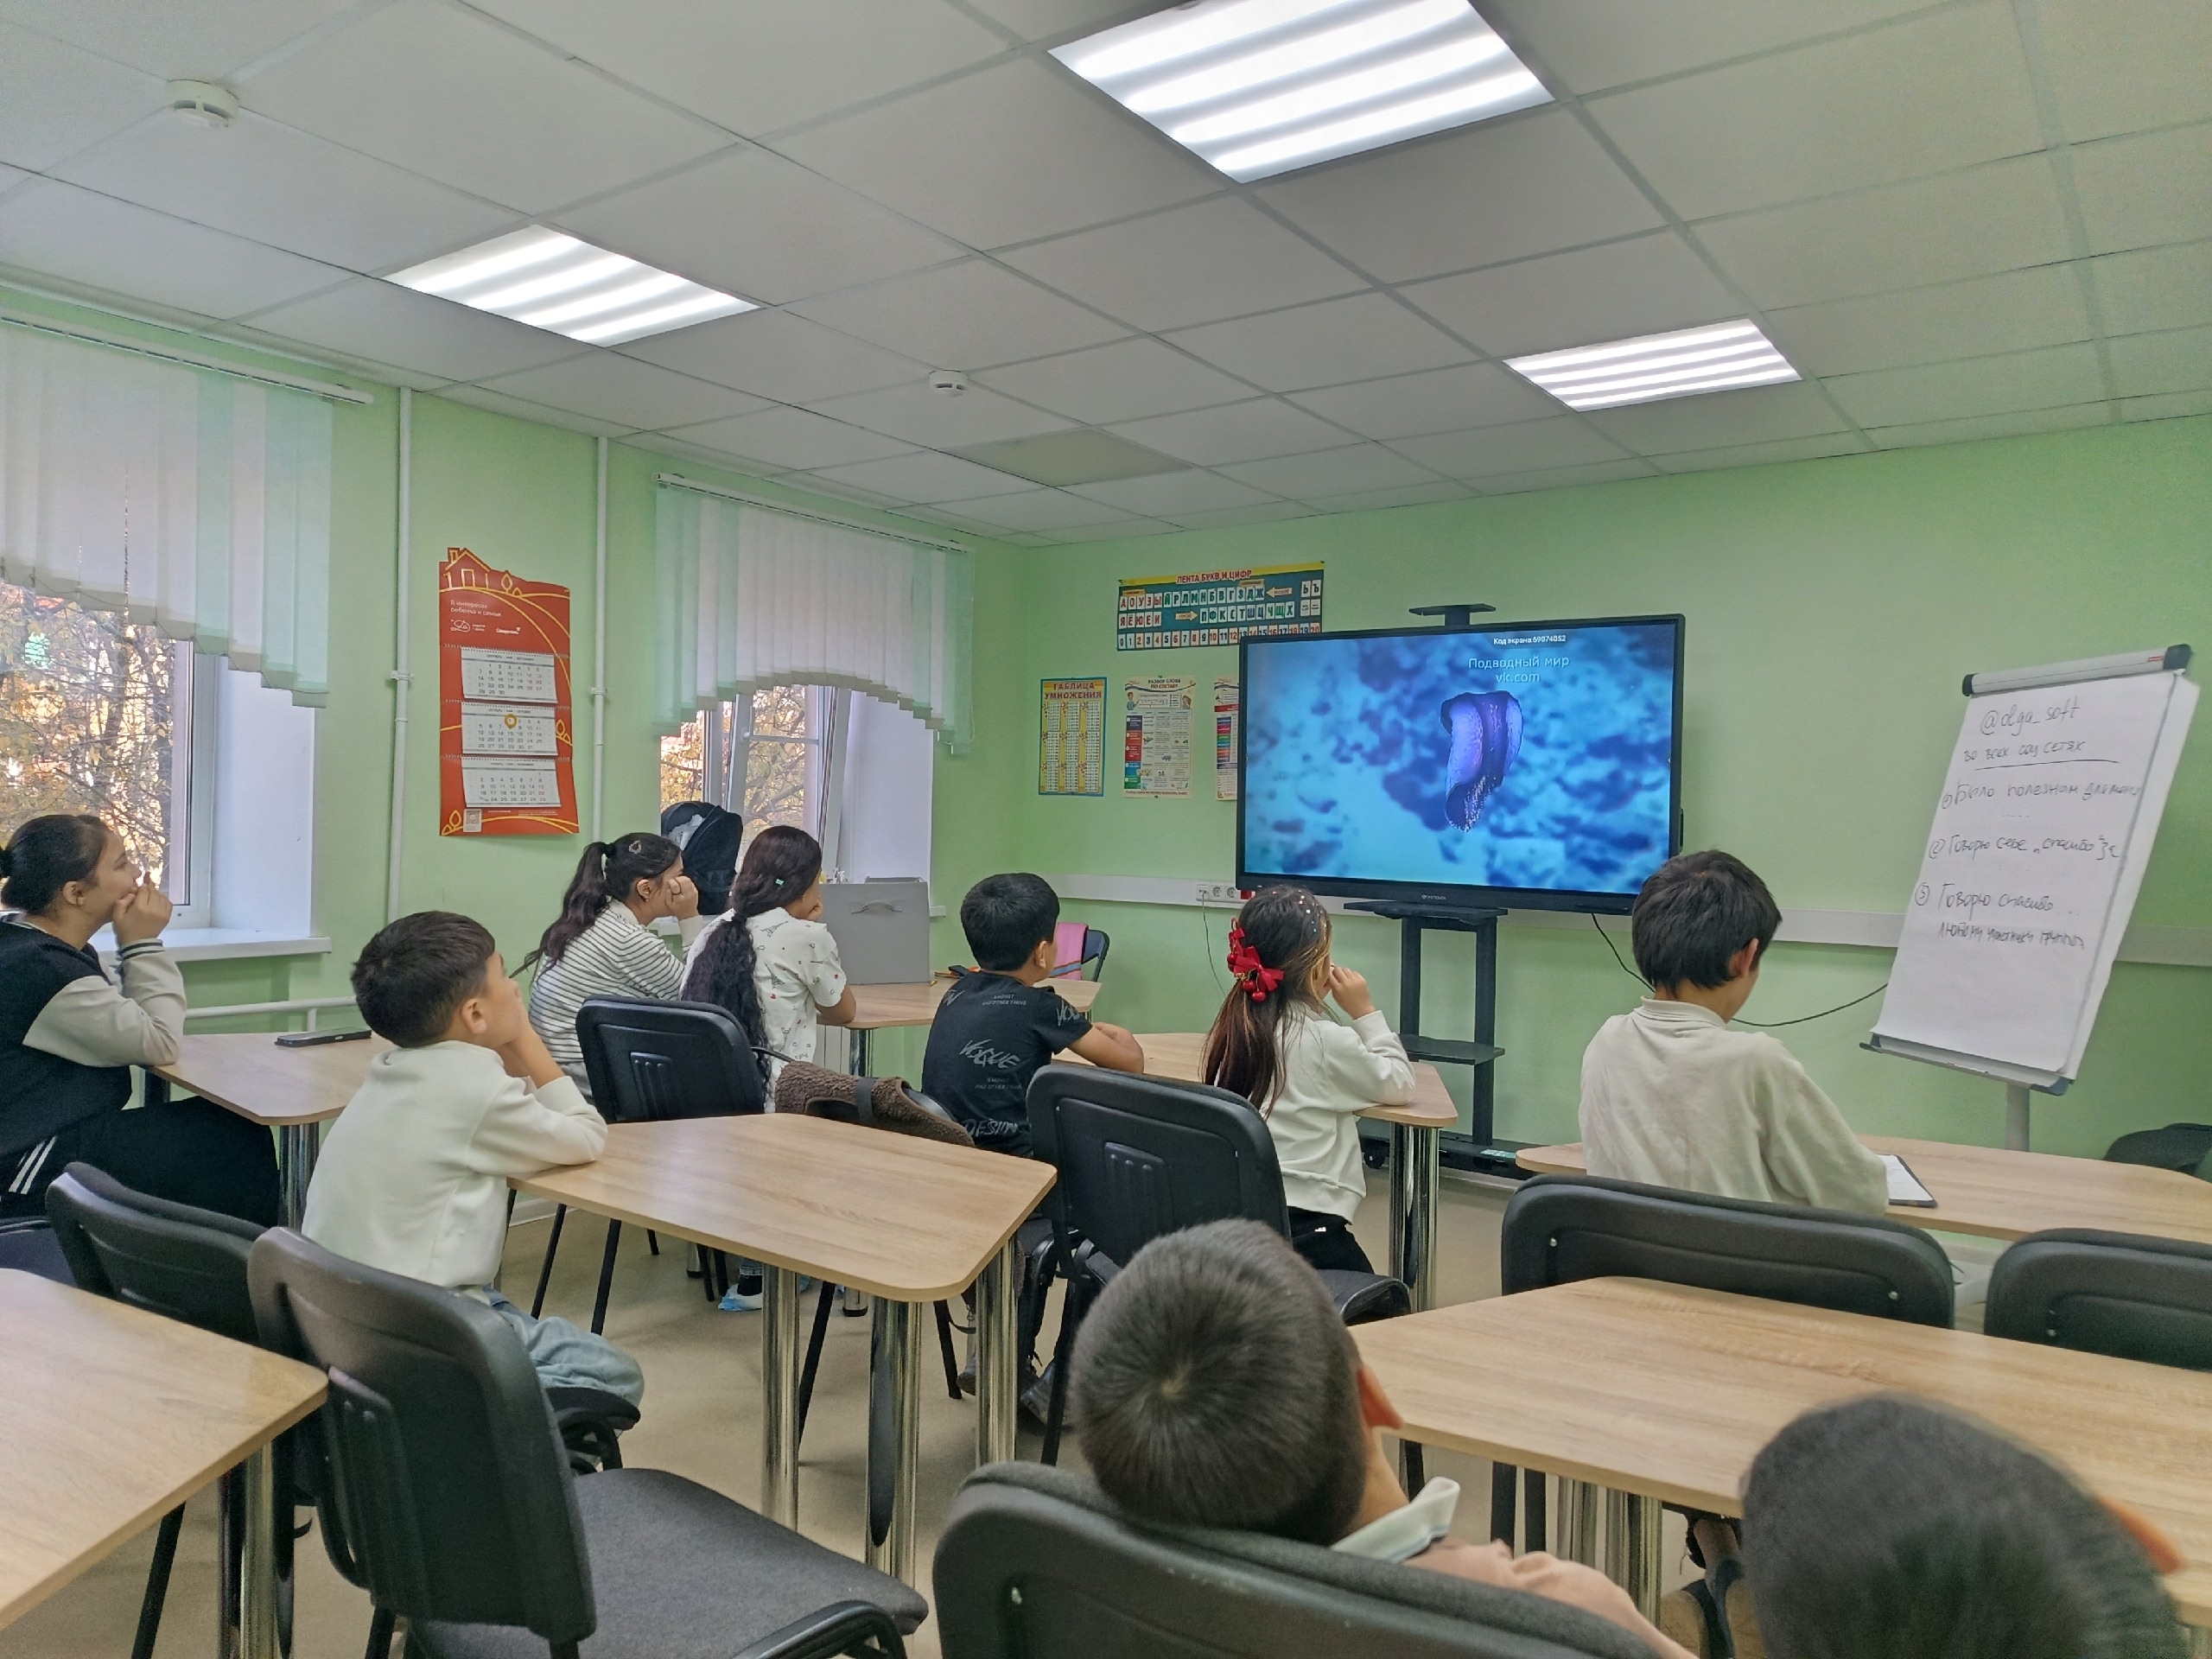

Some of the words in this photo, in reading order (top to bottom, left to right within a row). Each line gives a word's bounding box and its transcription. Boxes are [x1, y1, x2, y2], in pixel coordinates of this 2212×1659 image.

[1177, 575, 1199, 584] ЛЕНТА
[1201, 573, 1219, 582] БУКВ
[1230, 570, 1252, 580] ЦИФР
[1120, 638, 1124, 647] 0
[1137, 637, 1141, 645] 2
[1146, 637, 1151, 645] 3
[1155, 636, 1159, 645] 4
[1210, 633, 1217, 641] 10
[1220, 632, 1227, 640] 11
[1230, 632, 1237, 640] 12
[1469, 656, 1540, 669] Подводный
[1545, 656, 1569, 668] мир
[1496, 672, 1540, 683] vk.com
[1053, 682, 1095, 691] ТАБЛИЦА
[1938, 883, 1991, 921] Говорю
[959, 1039, 1020, 1069] VOGUE
